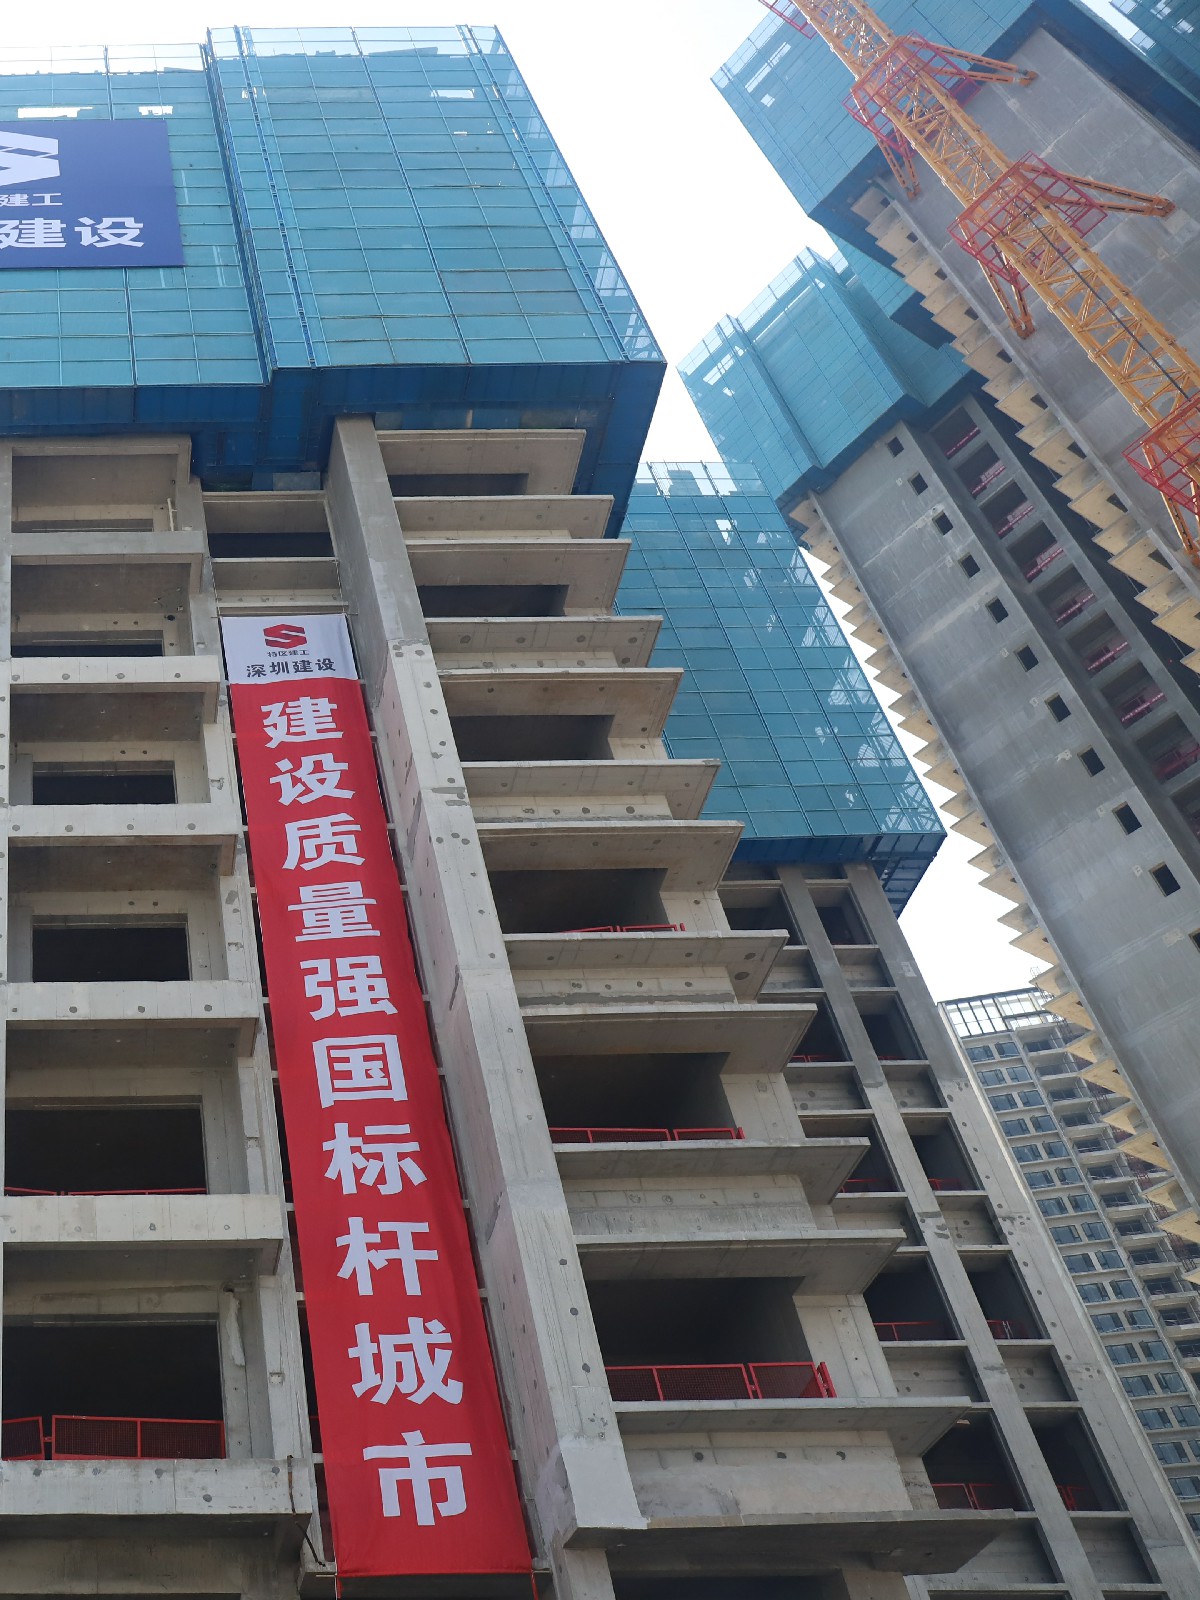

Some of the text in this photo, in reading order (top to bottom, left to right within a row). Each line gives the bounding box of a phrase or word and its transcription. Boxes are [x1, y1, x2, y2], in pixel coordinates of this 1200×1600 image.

[246, 657, 336, 678] 深圳建设
[260, 696, 473, 1526] 建设质量强国标杆城市
